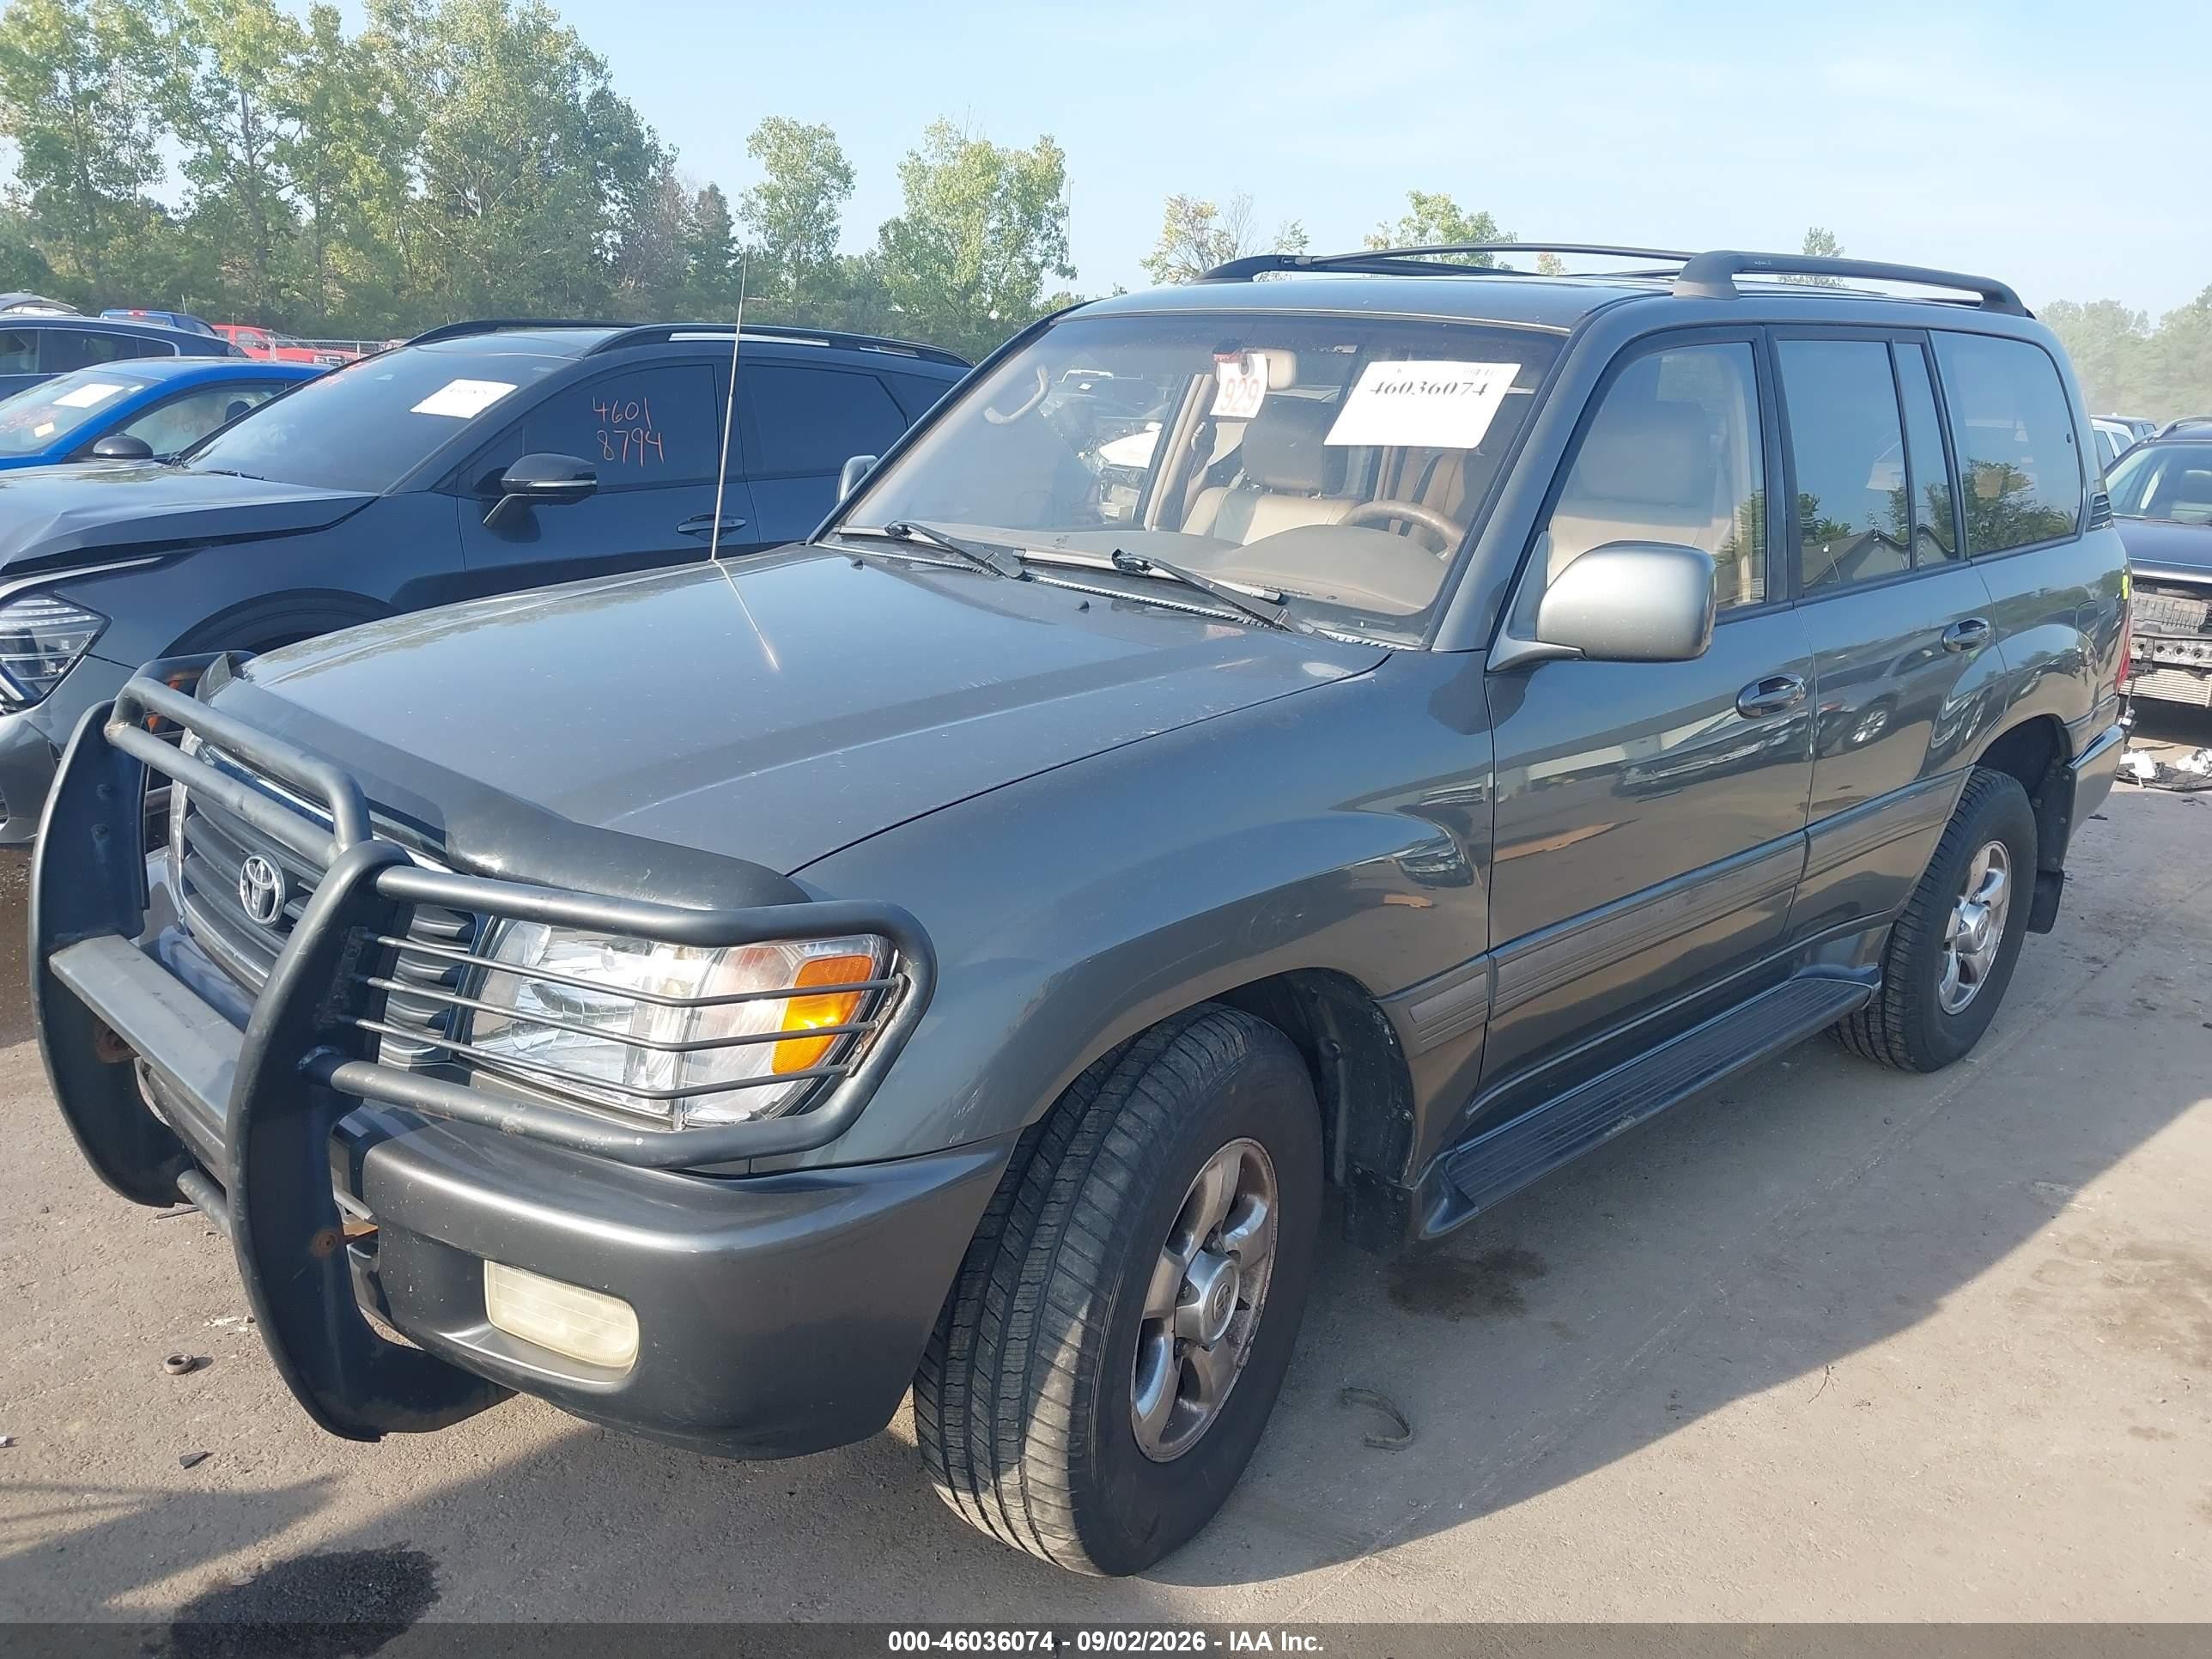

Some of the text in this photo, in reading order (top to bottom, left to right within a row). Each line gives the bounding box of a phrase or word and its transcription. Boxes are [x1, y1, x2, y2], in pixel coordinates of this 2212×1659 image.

[1219, 378, 1260, 413] 929
[1370, 380, 1489, 397] 46036074
[592, 396, 653, 430] 4601
[597, 428, 665, 467] 8794
